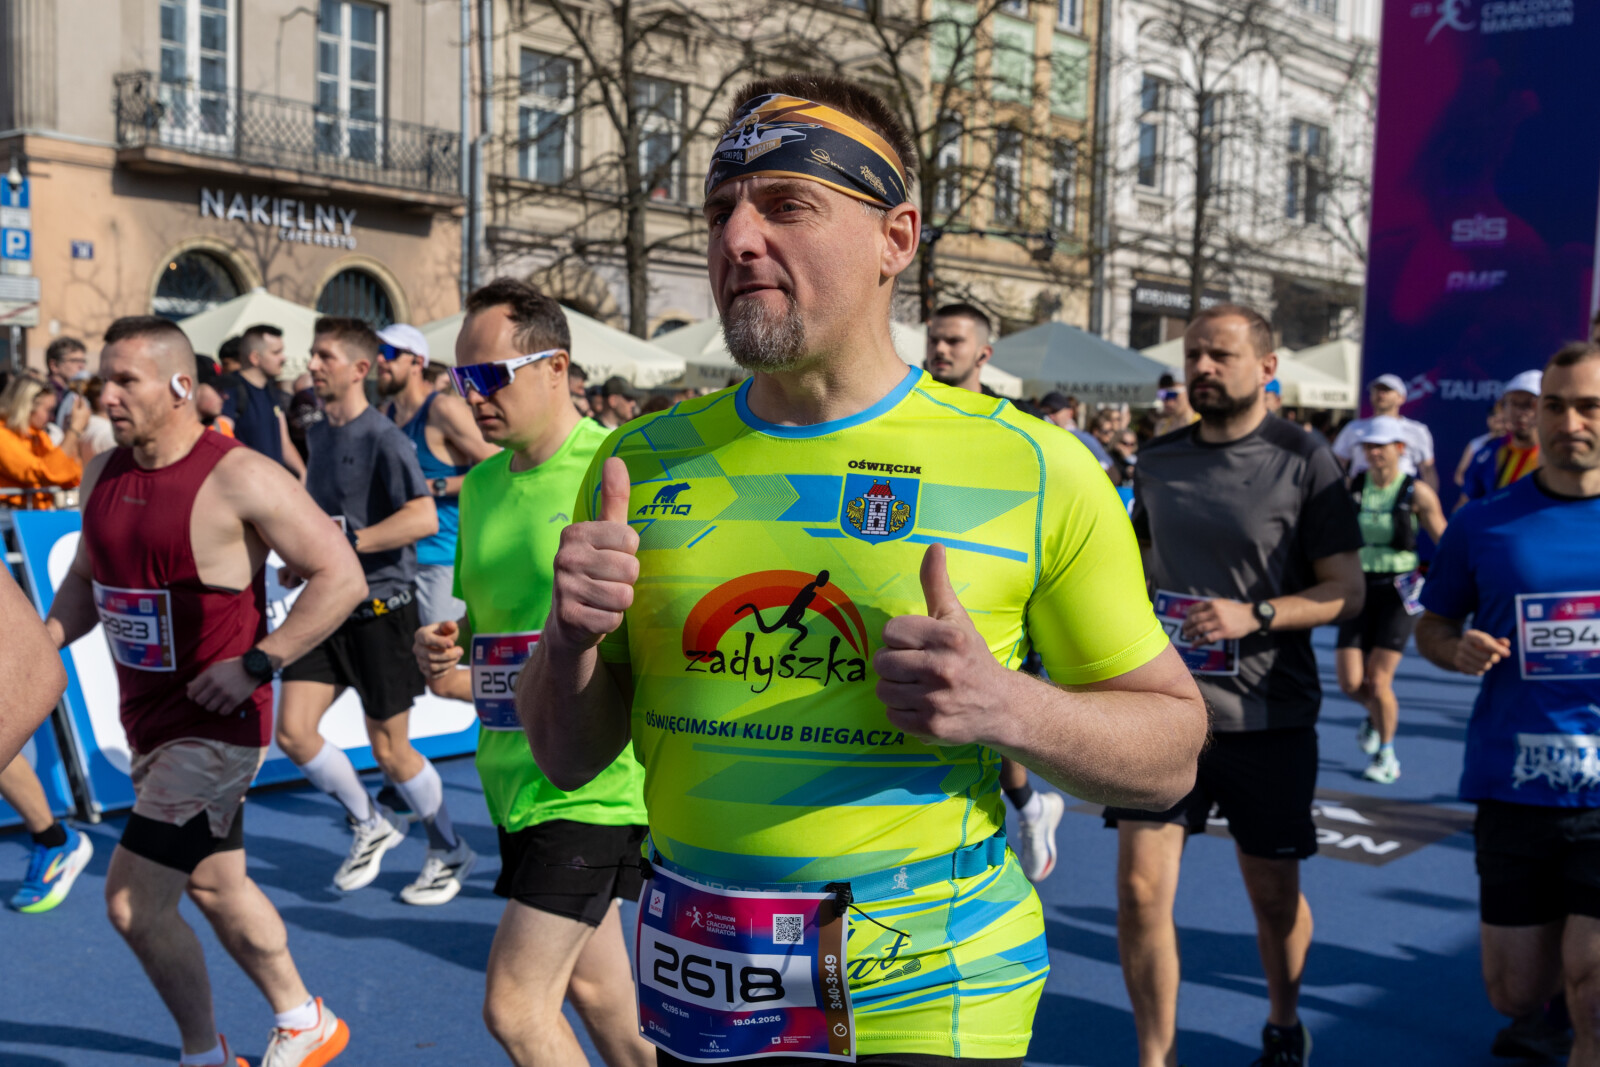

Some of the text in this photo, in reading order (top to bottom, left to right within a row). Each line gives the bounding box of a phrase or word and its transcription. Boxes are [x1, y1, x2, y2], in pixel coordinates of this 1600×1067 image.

[1481, 10, 1574, 33] MARATON
[733, 150, 744, 161] PÓŁ
[747, 140, 776, 160] MARATON
[200, 187, 357, 236] NAKIELNY
[6, 230, 27, 256] P
[1438, 380, 1508, 400] TAUR
[847, 459, 922, 475] OŚWIĘCIM
[635, 504, 692, 516] ATTIQ
[685, 632, 866, 693] zadyszka
[646, 709, 904, 746] OŚWIĘCIMSKI KLUB BIEGACZA
[706, 920, 736, 931] CRACOVIA
[714, 913, 736, 923] TAURON
[706, 926, 736, 937] MARATON
[654, 941, 785, 1003] 2618
[824, 954, 843, 1010] 3:40-3:49
[661, 1001, 690, 1019] 42,195 km
[732, 1014, 782, 1027] 19.04.2026
